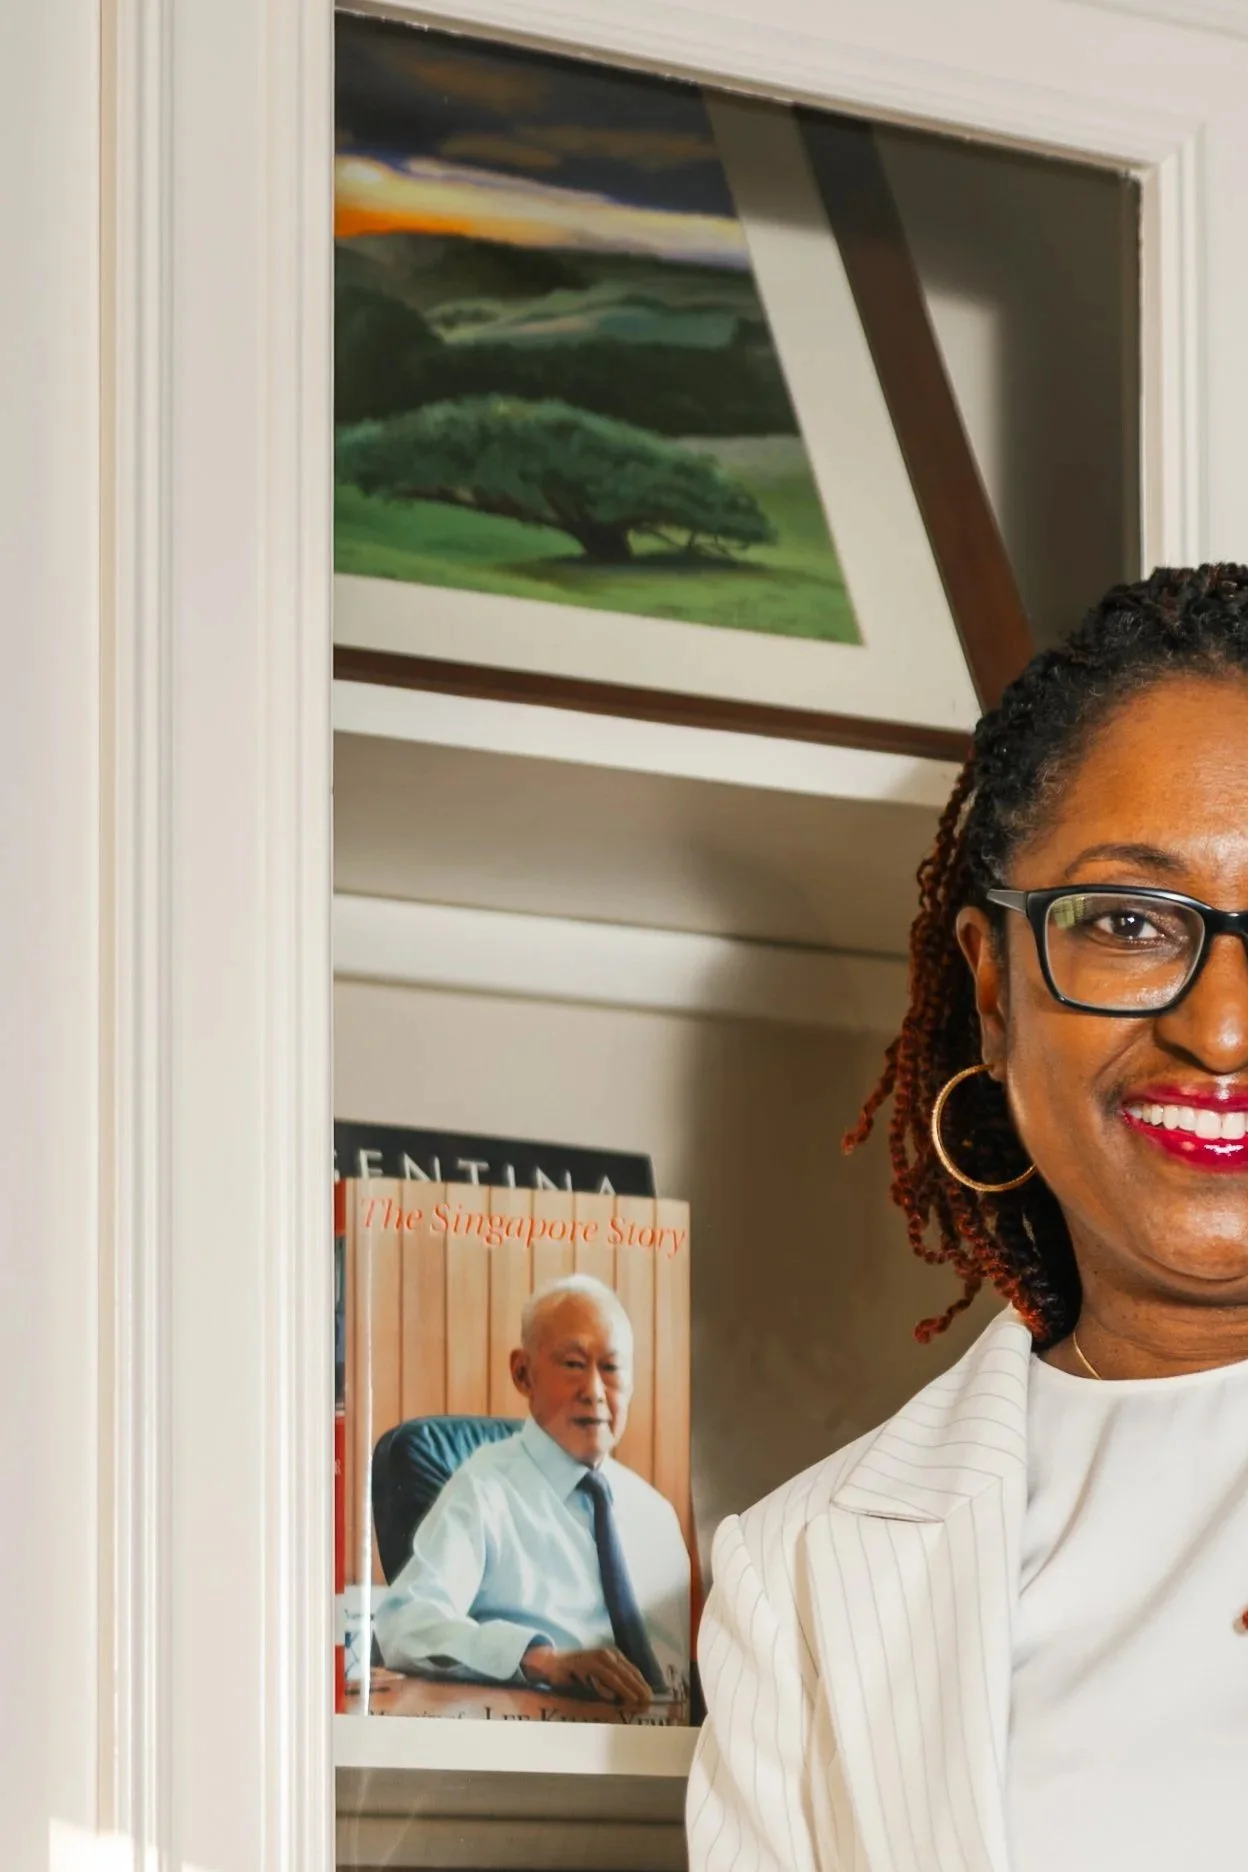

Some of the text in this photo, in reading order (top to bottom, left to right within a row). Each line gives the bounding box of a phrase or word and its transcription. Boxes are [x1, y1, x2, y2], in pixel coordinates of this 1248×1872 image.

[361, 1198, 686, 1258] The Singapore Story
